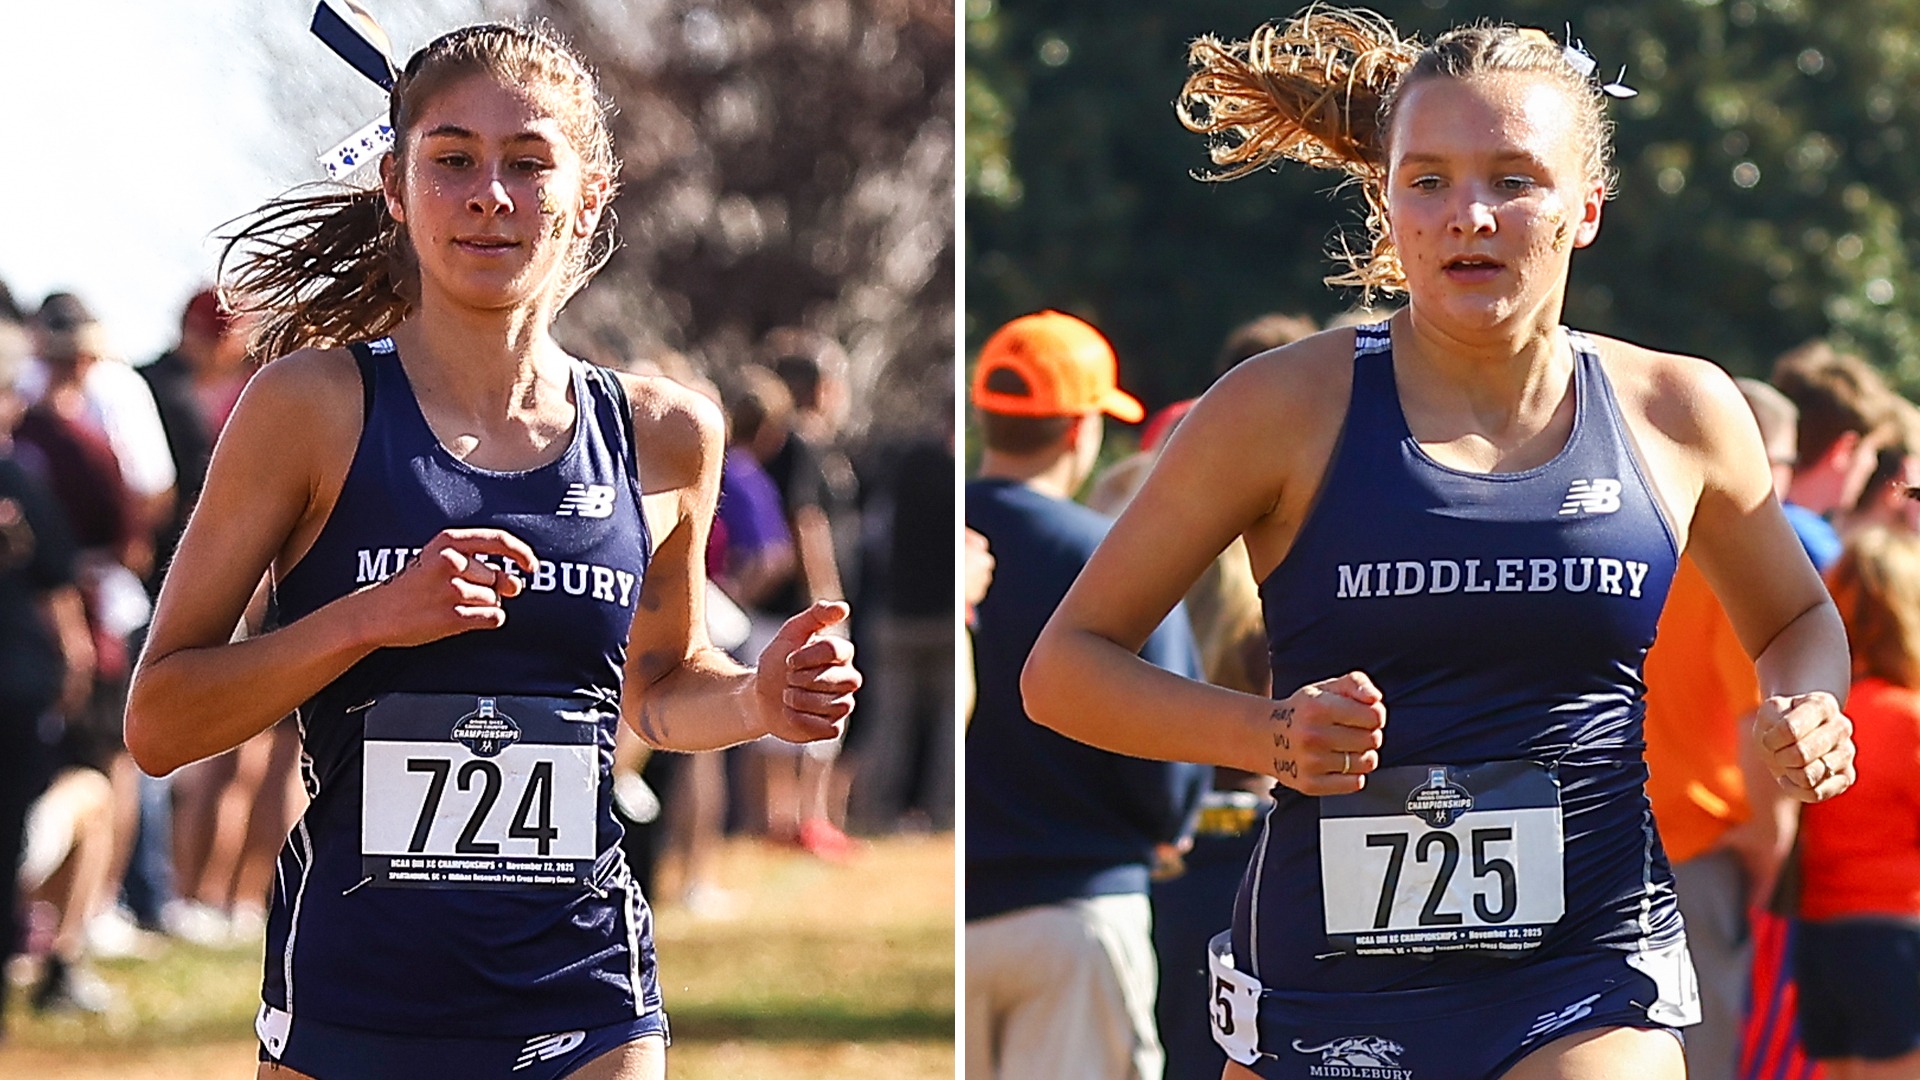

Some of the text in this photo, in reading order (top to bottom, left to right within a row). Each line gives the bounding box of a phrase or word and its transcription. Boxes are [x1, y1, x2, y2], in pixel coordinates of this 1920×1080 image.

[1336, 557, 1649, 598] MIDDLEBURY
[453, 729, 519, 739] CHAMPIONSHIPS
[407, 758, 558, 856] 724
[1408, 798, 1471, 810] CHAMPIONSHIPS
[437, 859, 495, 870] CHAMPIONSHIPS
[506, 861, 543, 871] November
[1366, 827, 1518, 929] 725
[1356, 935, 1375, 945] NCAA
[1400, 931, 1457, 943] CHAMPIONSHIPS
[1469, 930, 1507, 940] November
[1522, 927, 1542, 937] 2025
[1309, 1065, 1413, 1080] MIDDLEBURY
